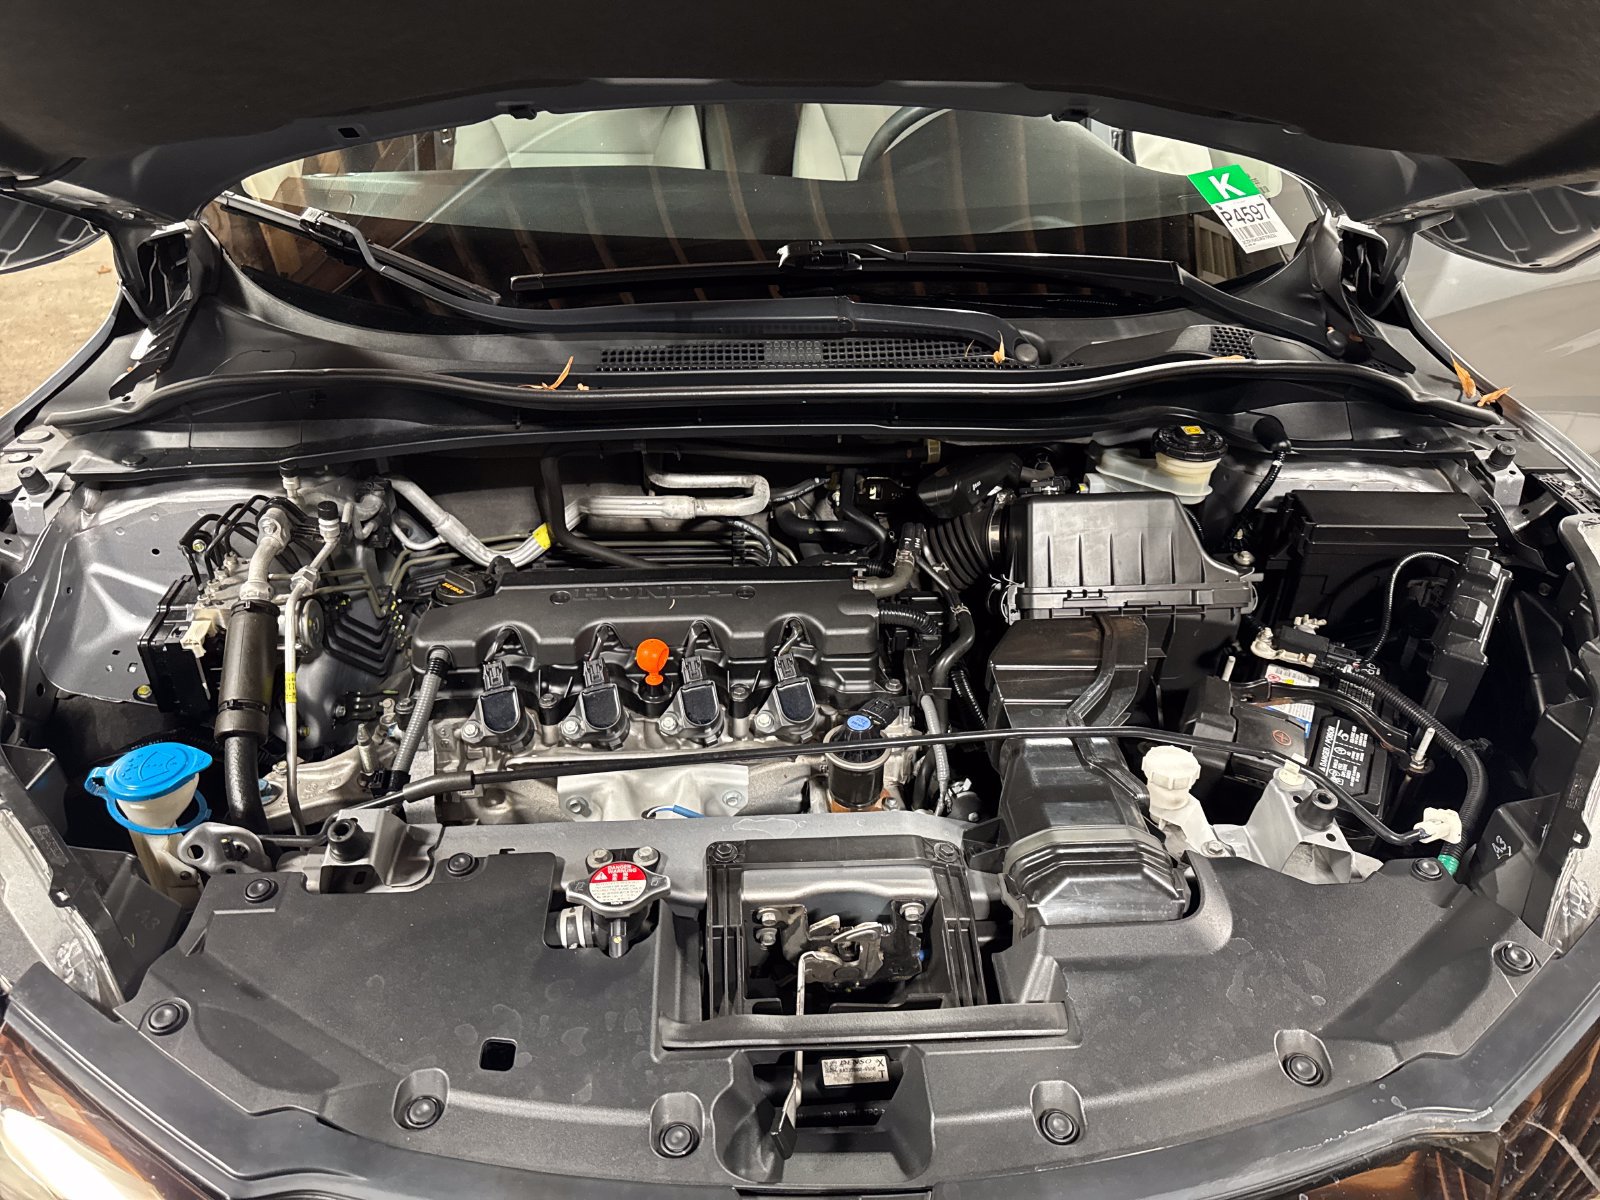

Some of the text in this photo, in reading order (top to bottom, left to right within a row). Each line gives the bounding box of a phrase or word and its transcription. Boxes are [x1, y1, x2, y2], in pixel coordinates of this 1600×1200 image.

[1208, 172, 1246, 199] K
[1219, 203, 1270, 227] P4597
[573, 585, 733, 601] HONDA
[840, 1058, 872, 1066] DENSO
